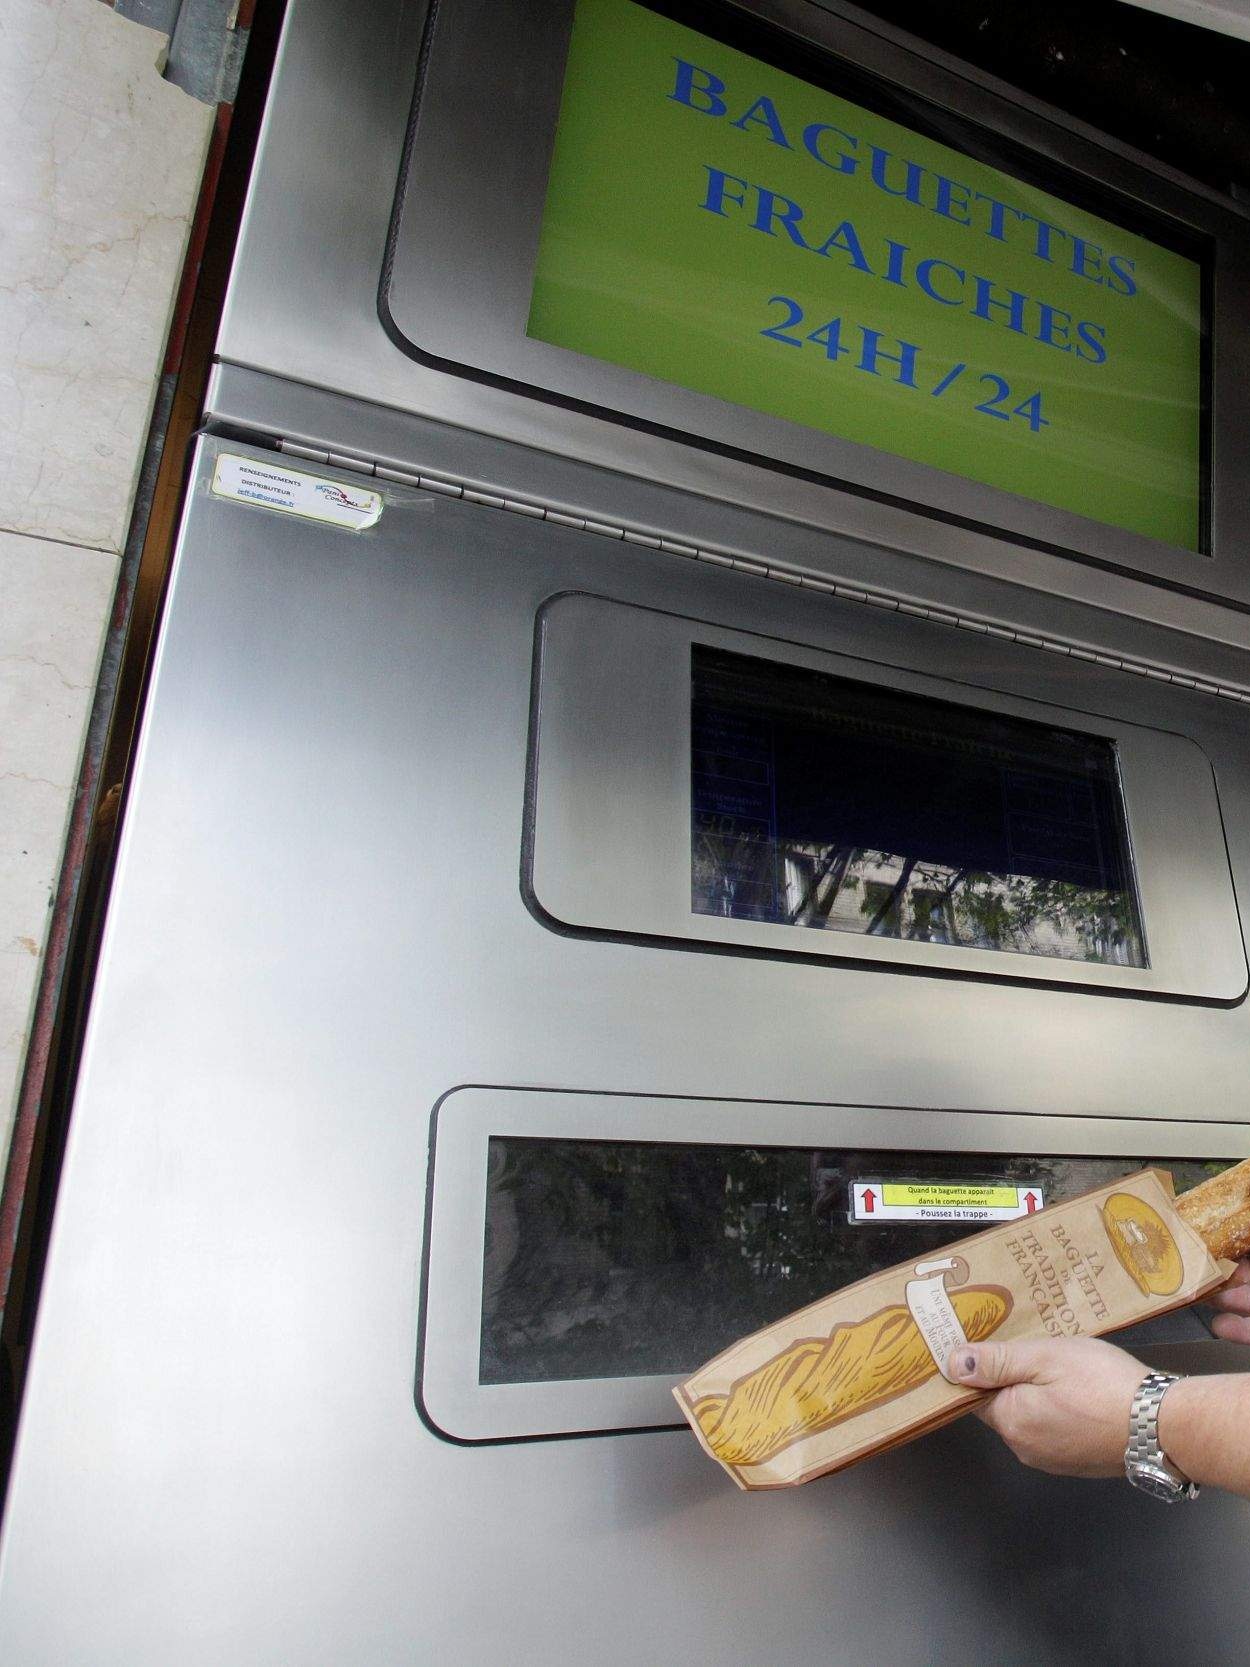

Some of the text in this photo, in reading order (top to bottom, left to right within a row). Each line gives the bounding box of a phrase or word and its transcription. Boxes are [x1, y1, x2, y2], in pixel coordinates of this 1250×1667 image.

[666, 57, 1138, 297] BAGUETTES
[699, 164, 1109, 365] FRAICHES
[239, 467, 302, 487] RENSEIGNEMENTS
[241, 479, 291, 496] DISTRIBUTEUR
[907, 1186, 930, 1194] Quand
[939, 1187, 967, 1196] baguette
[921, 1209, 952, 1218] Poussez
[954, 1210, 961, 1218] la
[963, 1210, 988, 1219] trappe
[1050, 1224, 1109, 1321] BAGUETTE
[1085, 1251, 1104, 1278] LA
[1021, 1230, 1085, 1336] TRADITION
